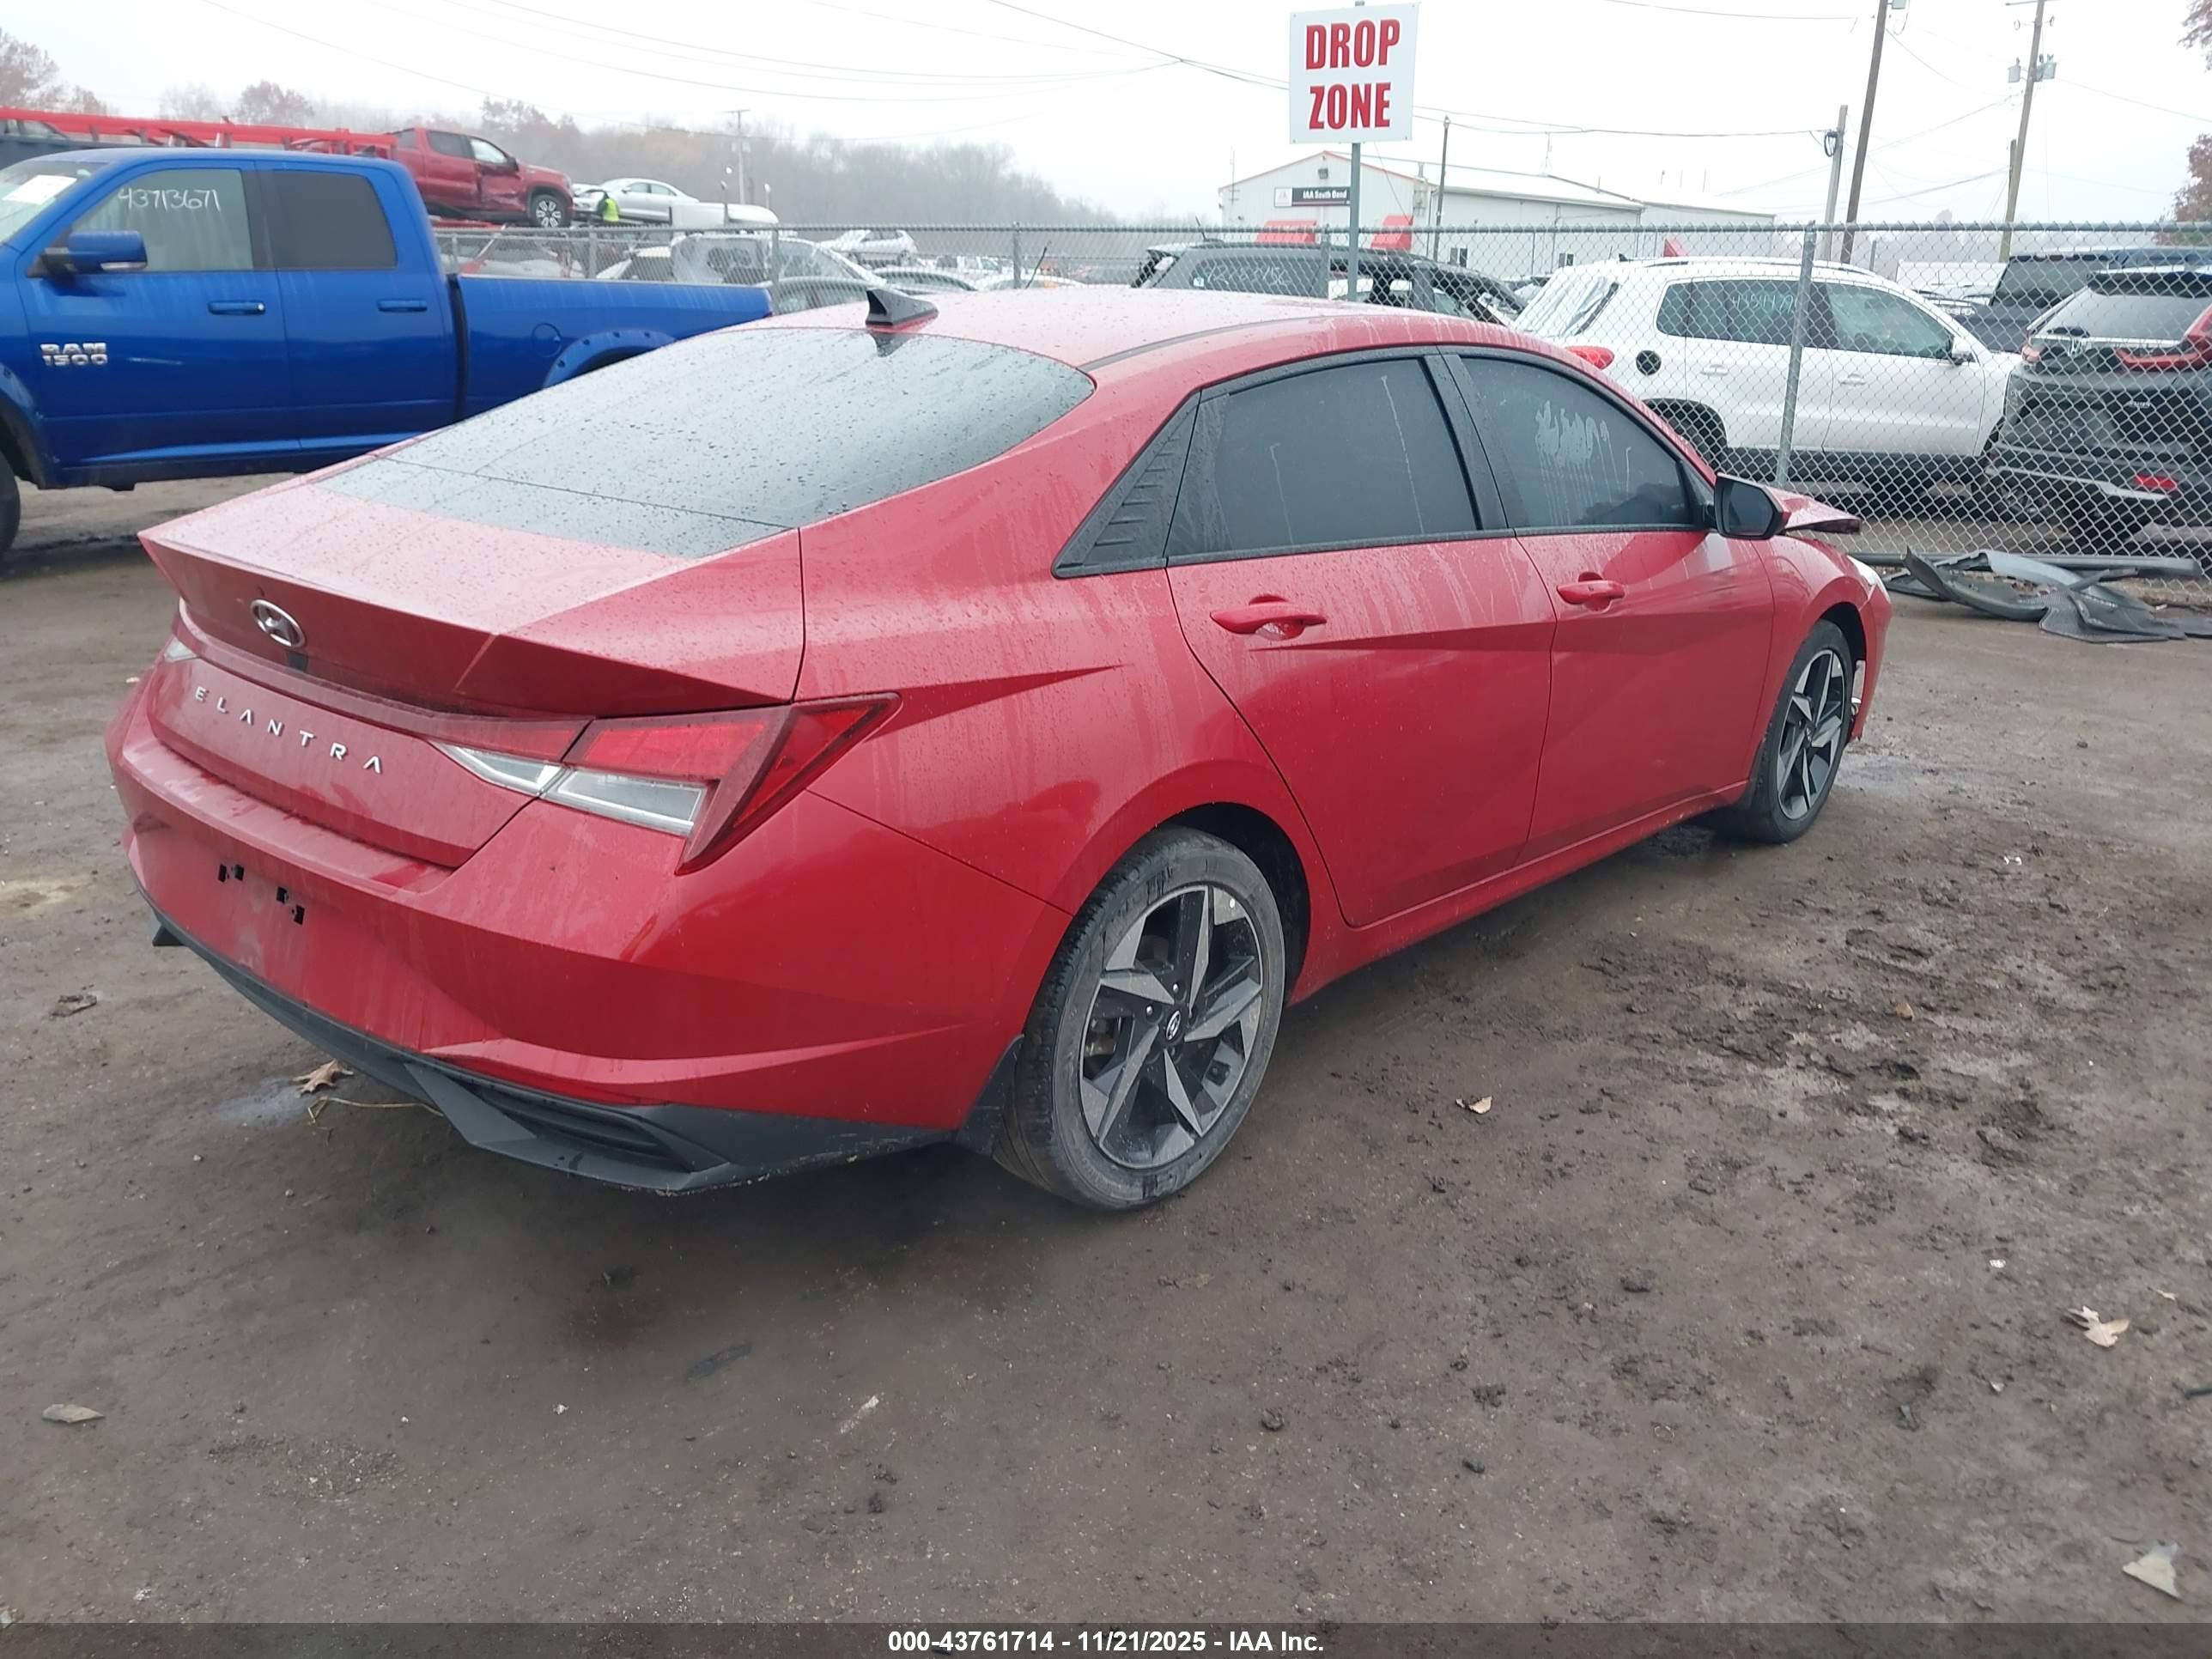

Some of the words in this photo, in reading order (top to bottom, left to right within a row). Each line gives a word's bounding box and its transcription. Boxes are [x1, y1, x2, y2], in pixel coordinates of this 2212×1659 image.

[1305, 19, 1401, 70] DROP
[1309, 82, 1391, 130] ZONE
[118, 187, 221, 212] 43713671
[40, 342, 106, 355] RAM
[42, 354, 108, 367] 1500
[195, 686, 382, 775] ELANTRA
